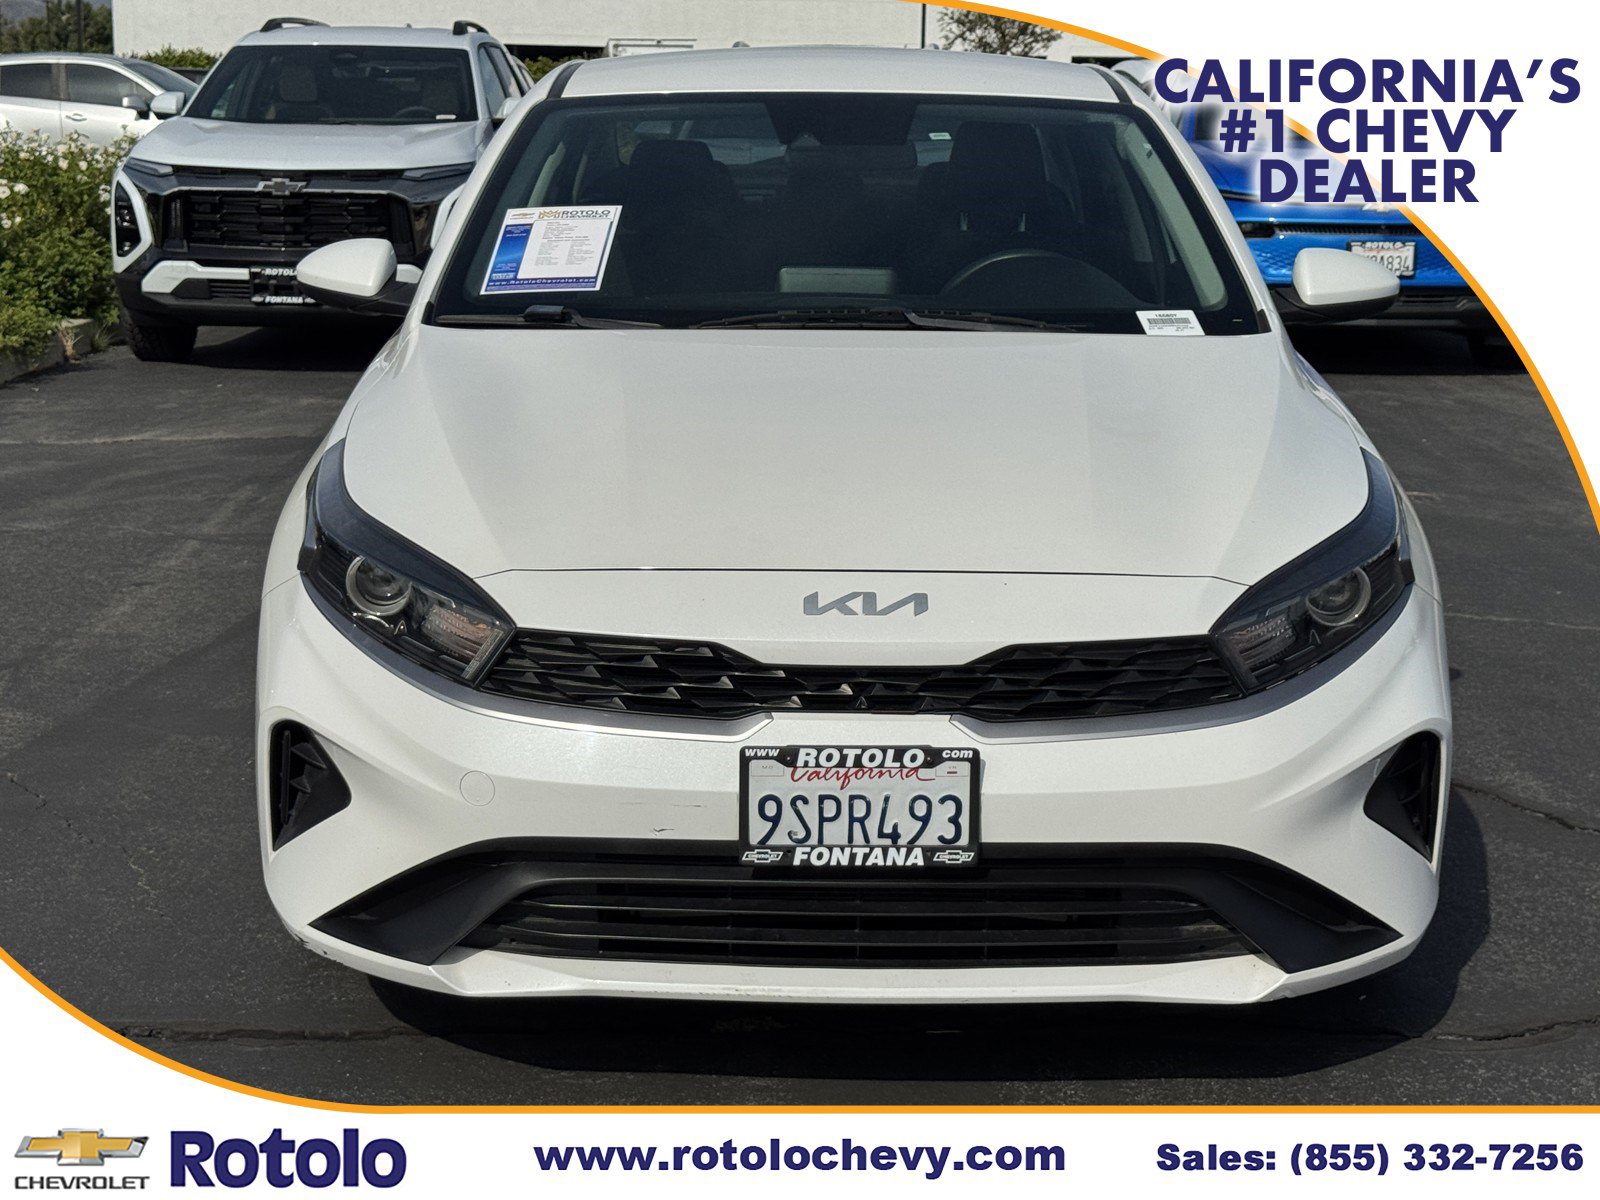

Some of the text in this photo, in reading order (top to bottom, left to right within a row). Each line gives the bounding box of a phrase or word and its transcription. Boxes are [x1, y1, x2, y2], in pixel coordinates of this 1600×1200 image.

[803, 591, 928, 616] KIA
[745, 748, 973, 768] www ROTOLO com
[756, 794, 963, 845] 9SPR493
[793, 847, 925, 866] FONTANA
